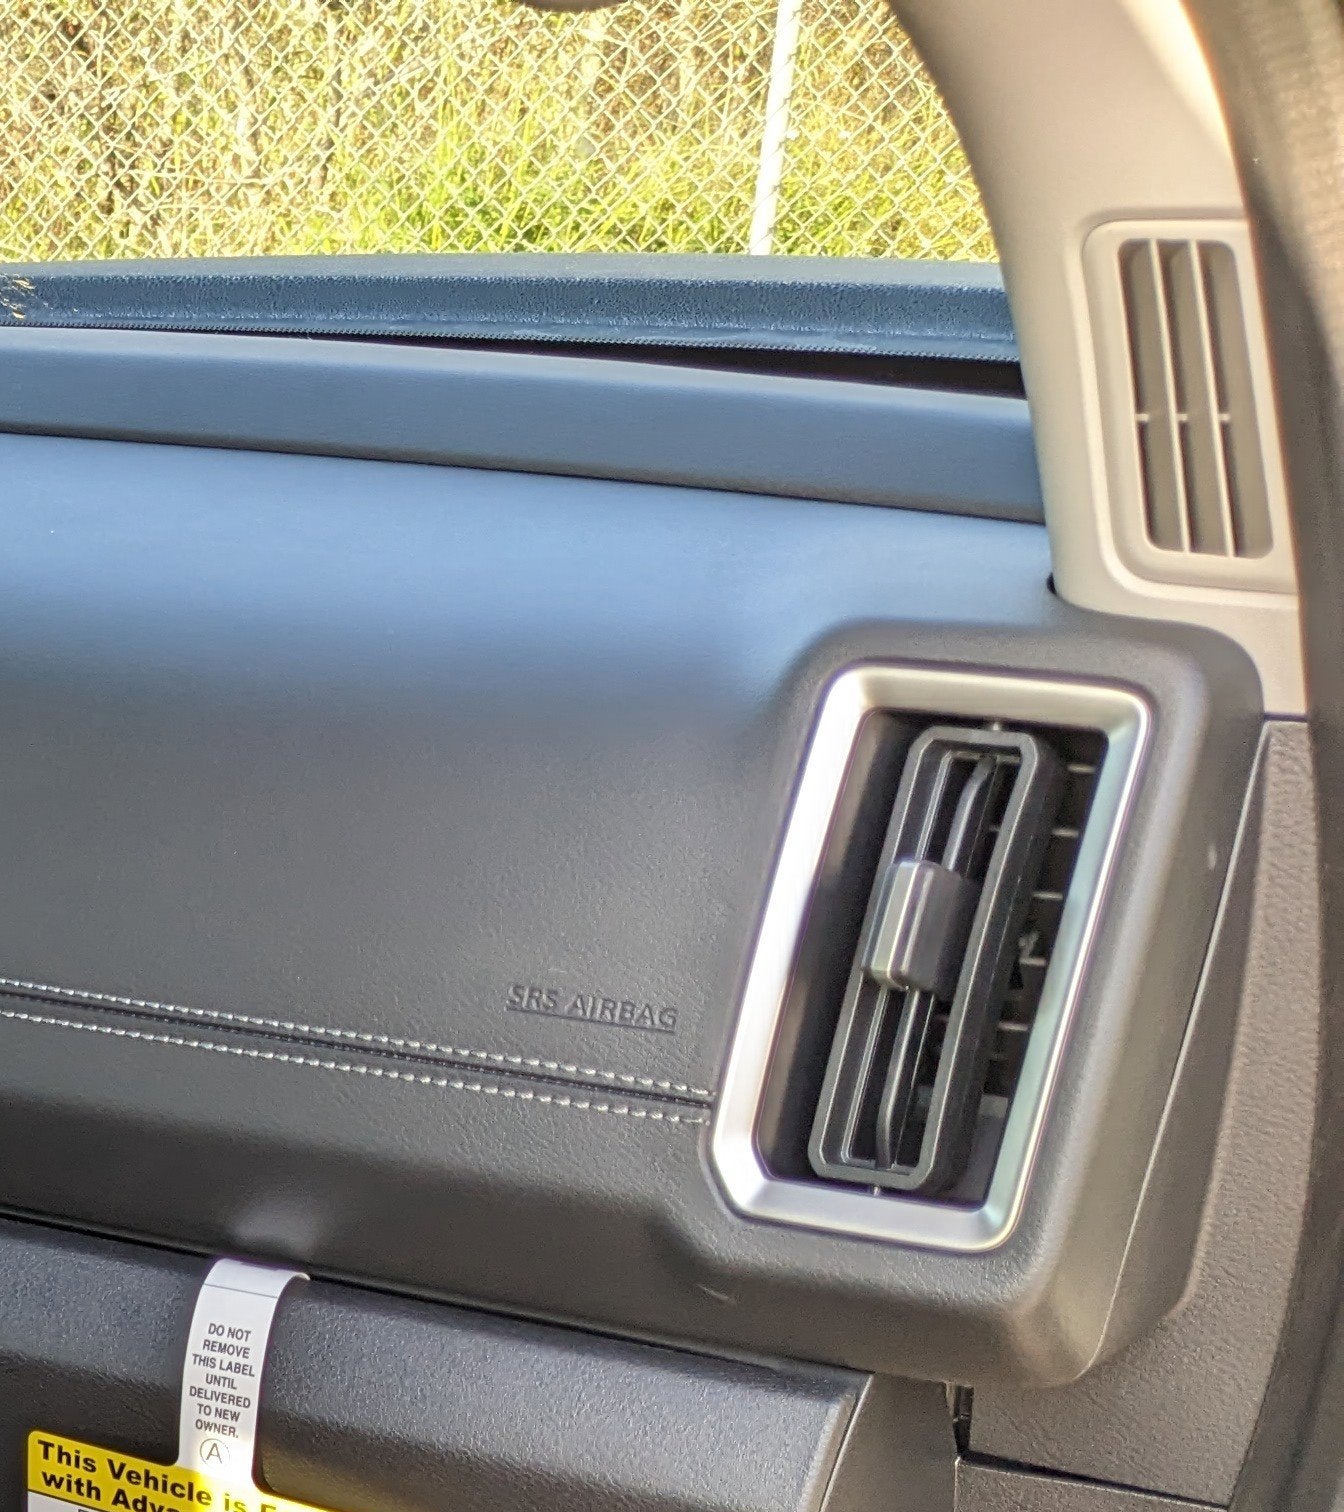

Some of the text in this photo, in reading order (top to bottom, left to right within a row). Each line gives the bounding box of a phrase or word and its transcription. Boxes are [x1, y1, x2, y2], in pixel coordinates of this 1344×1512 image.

[507, 985, 678, 1032] SRS AIRBAG
[207, 1323, 252, 1342] DO NOT
[202, 1339, 251, 1360] REMOVE
[192, 1353, 256, 1378] THIS LABEL
[205, 1373, 238, 1390] UNTIL
[189, 1385, 251, 1409] DELIVERED
[197, 1403, 241, 1422] TO NEW
[195, 1418, 239, 1439] OWNER.
[37, 1439, 97, 1473] This
[107, 1458, 212, 1506] Vehicle
[41, 1471, 102, 1502] with
